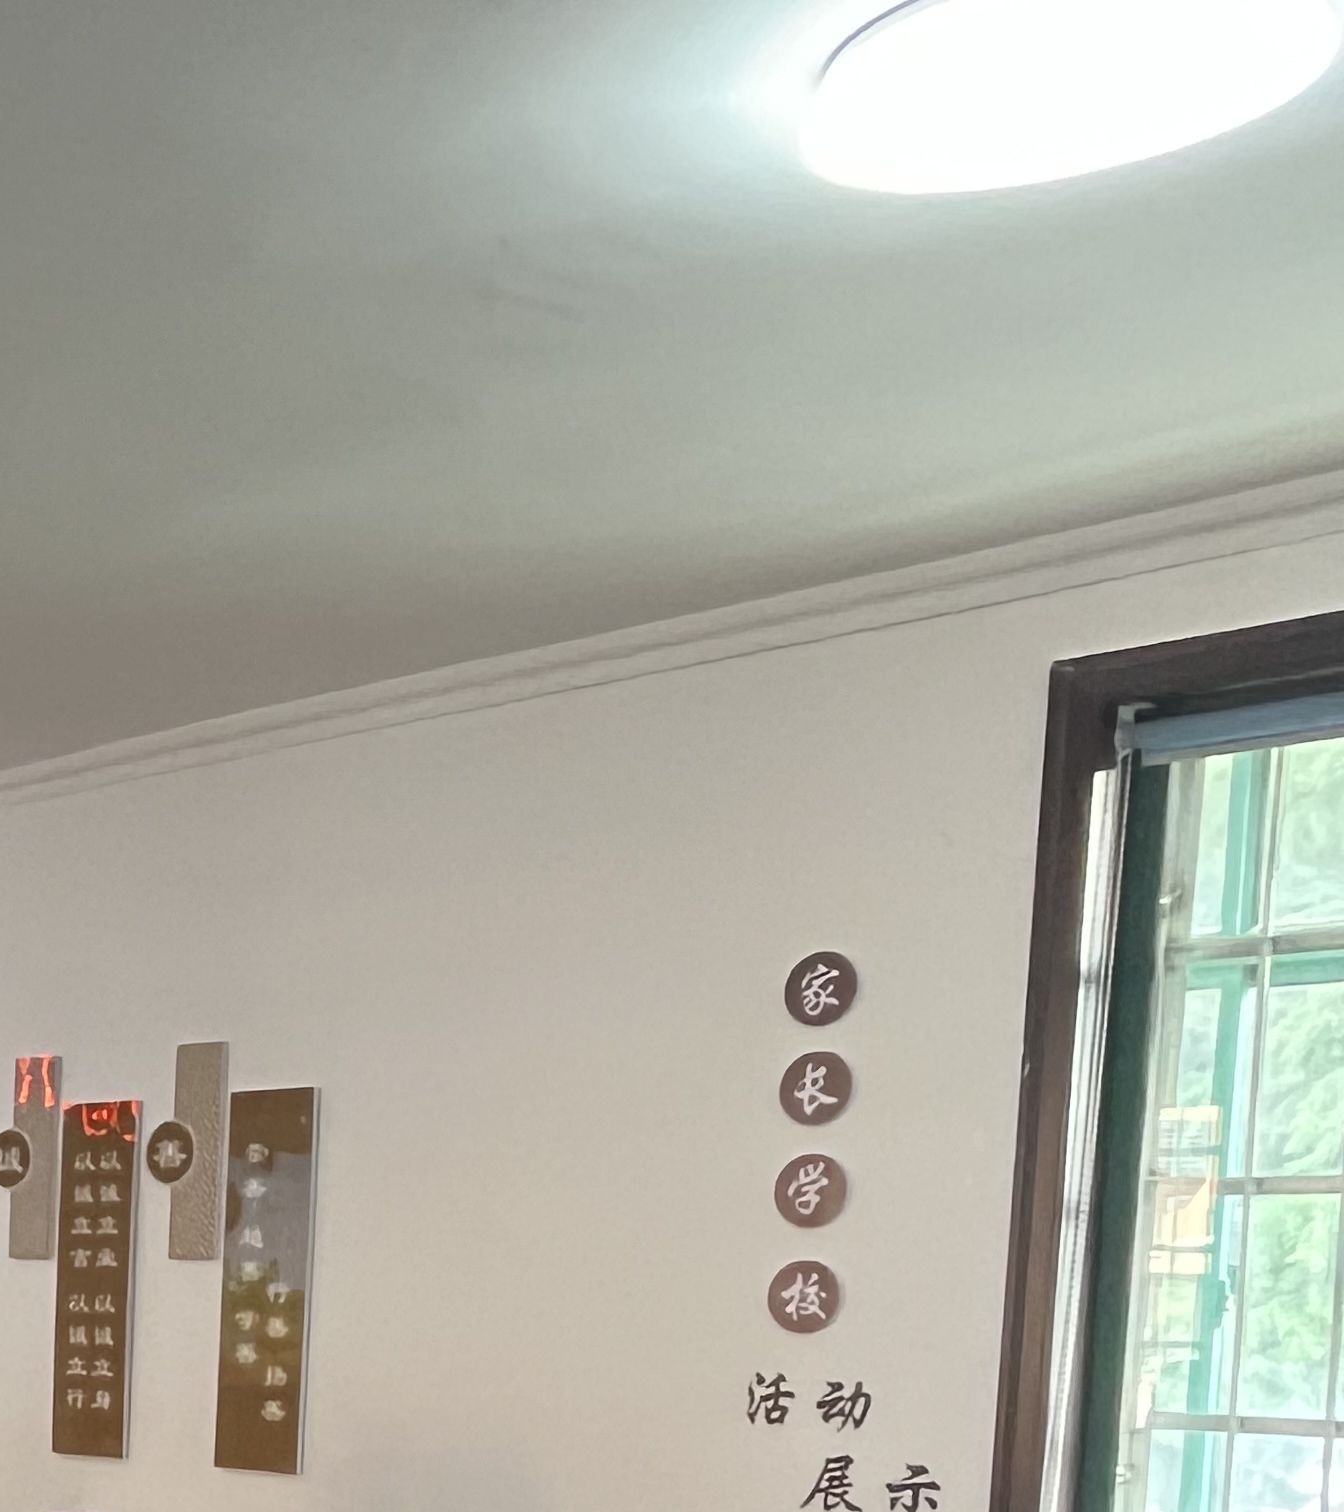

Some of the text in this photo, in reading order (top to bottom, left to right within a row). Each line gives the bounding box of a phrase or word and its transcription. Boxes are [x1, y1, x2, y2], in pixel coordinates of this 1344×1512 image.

[780, 963, 841, 1322] 家长学校
[747, 1372, 872, 1432] 活动
